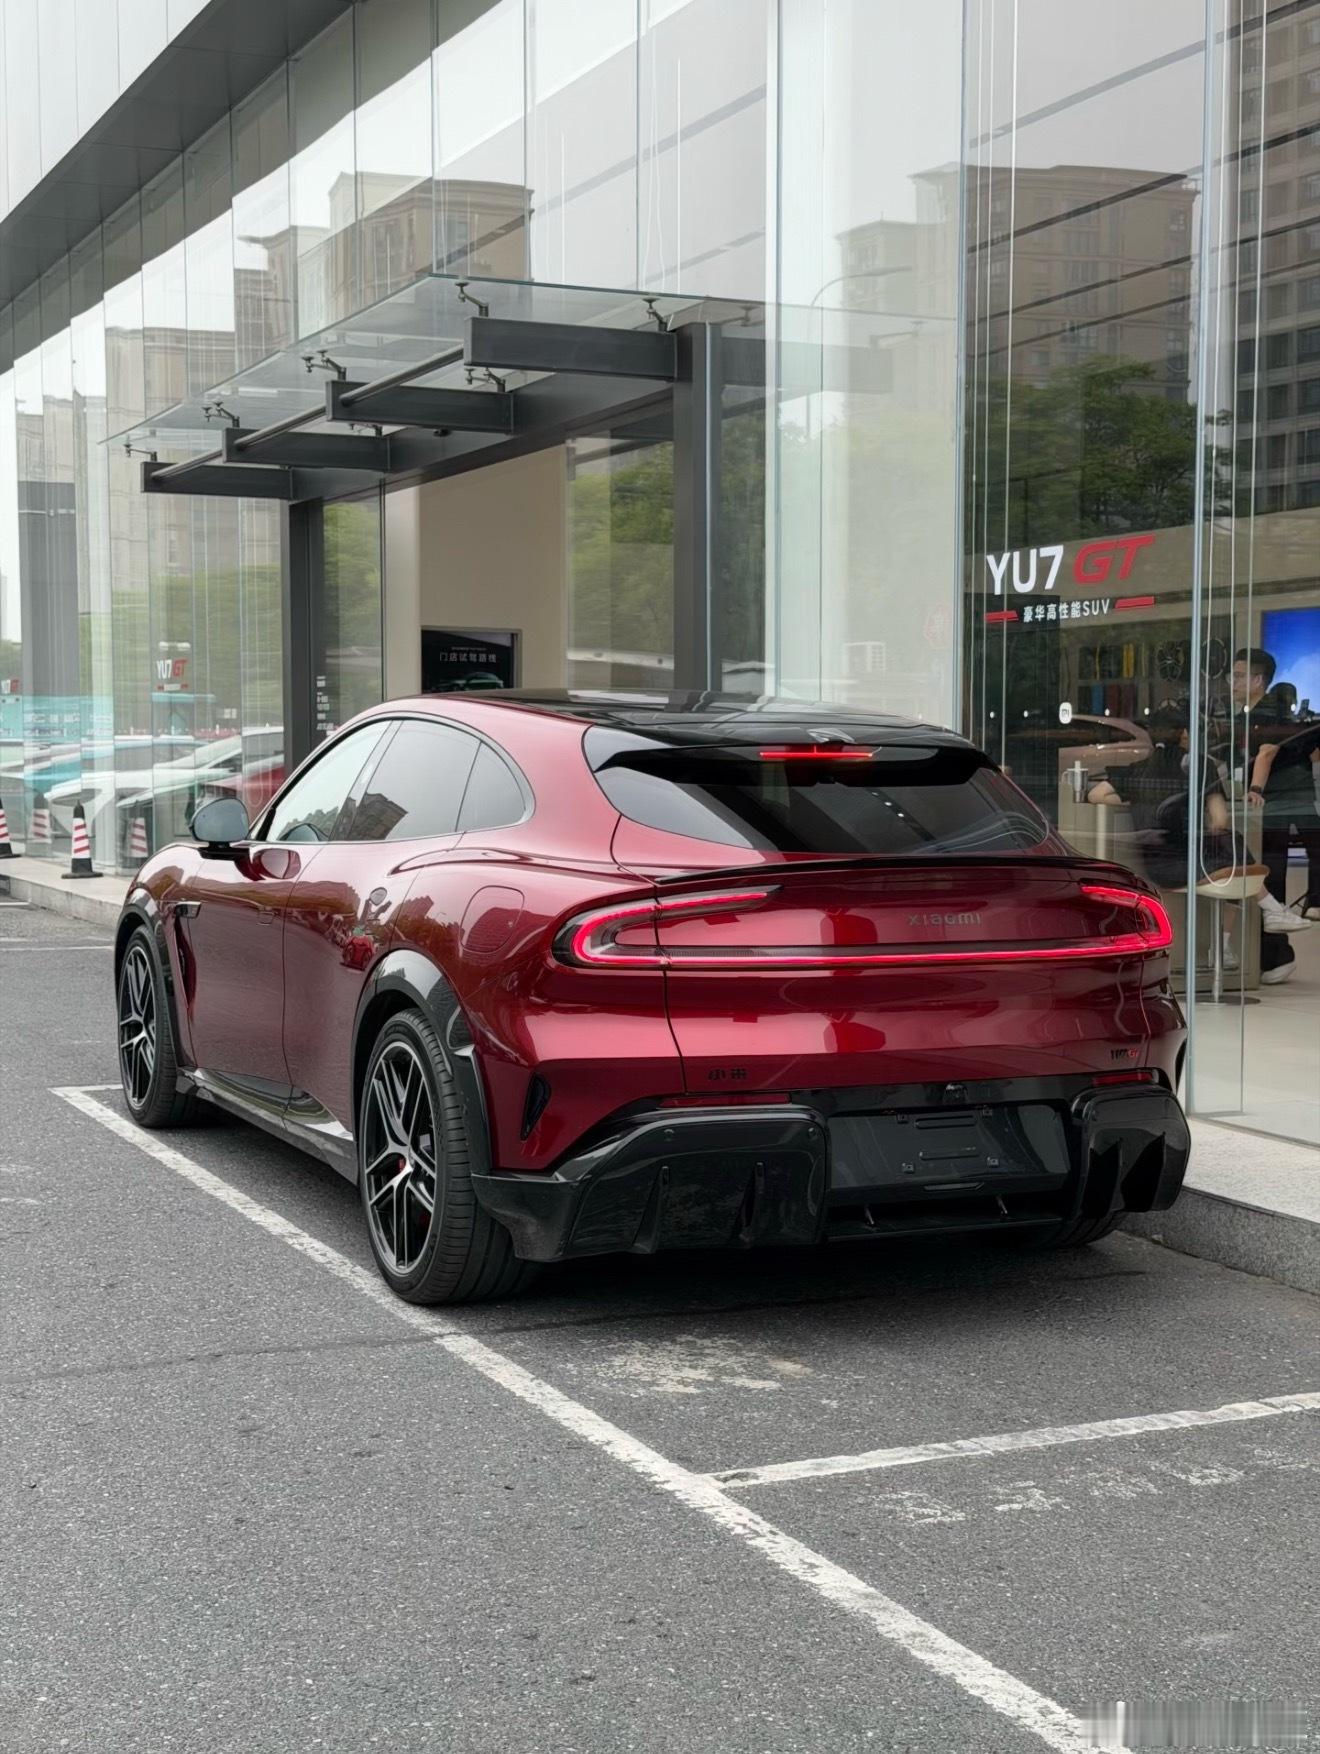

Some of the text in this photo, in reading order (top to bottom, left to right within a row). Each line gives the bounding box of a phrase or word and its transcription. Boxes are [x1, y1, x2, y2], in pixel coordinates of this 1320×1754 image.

[986, 533, 1156, 596] YU7 GT
[1023, 599, 1110, 623] 豪华高性能SUV
[156, 659, 173, 679] YU7
